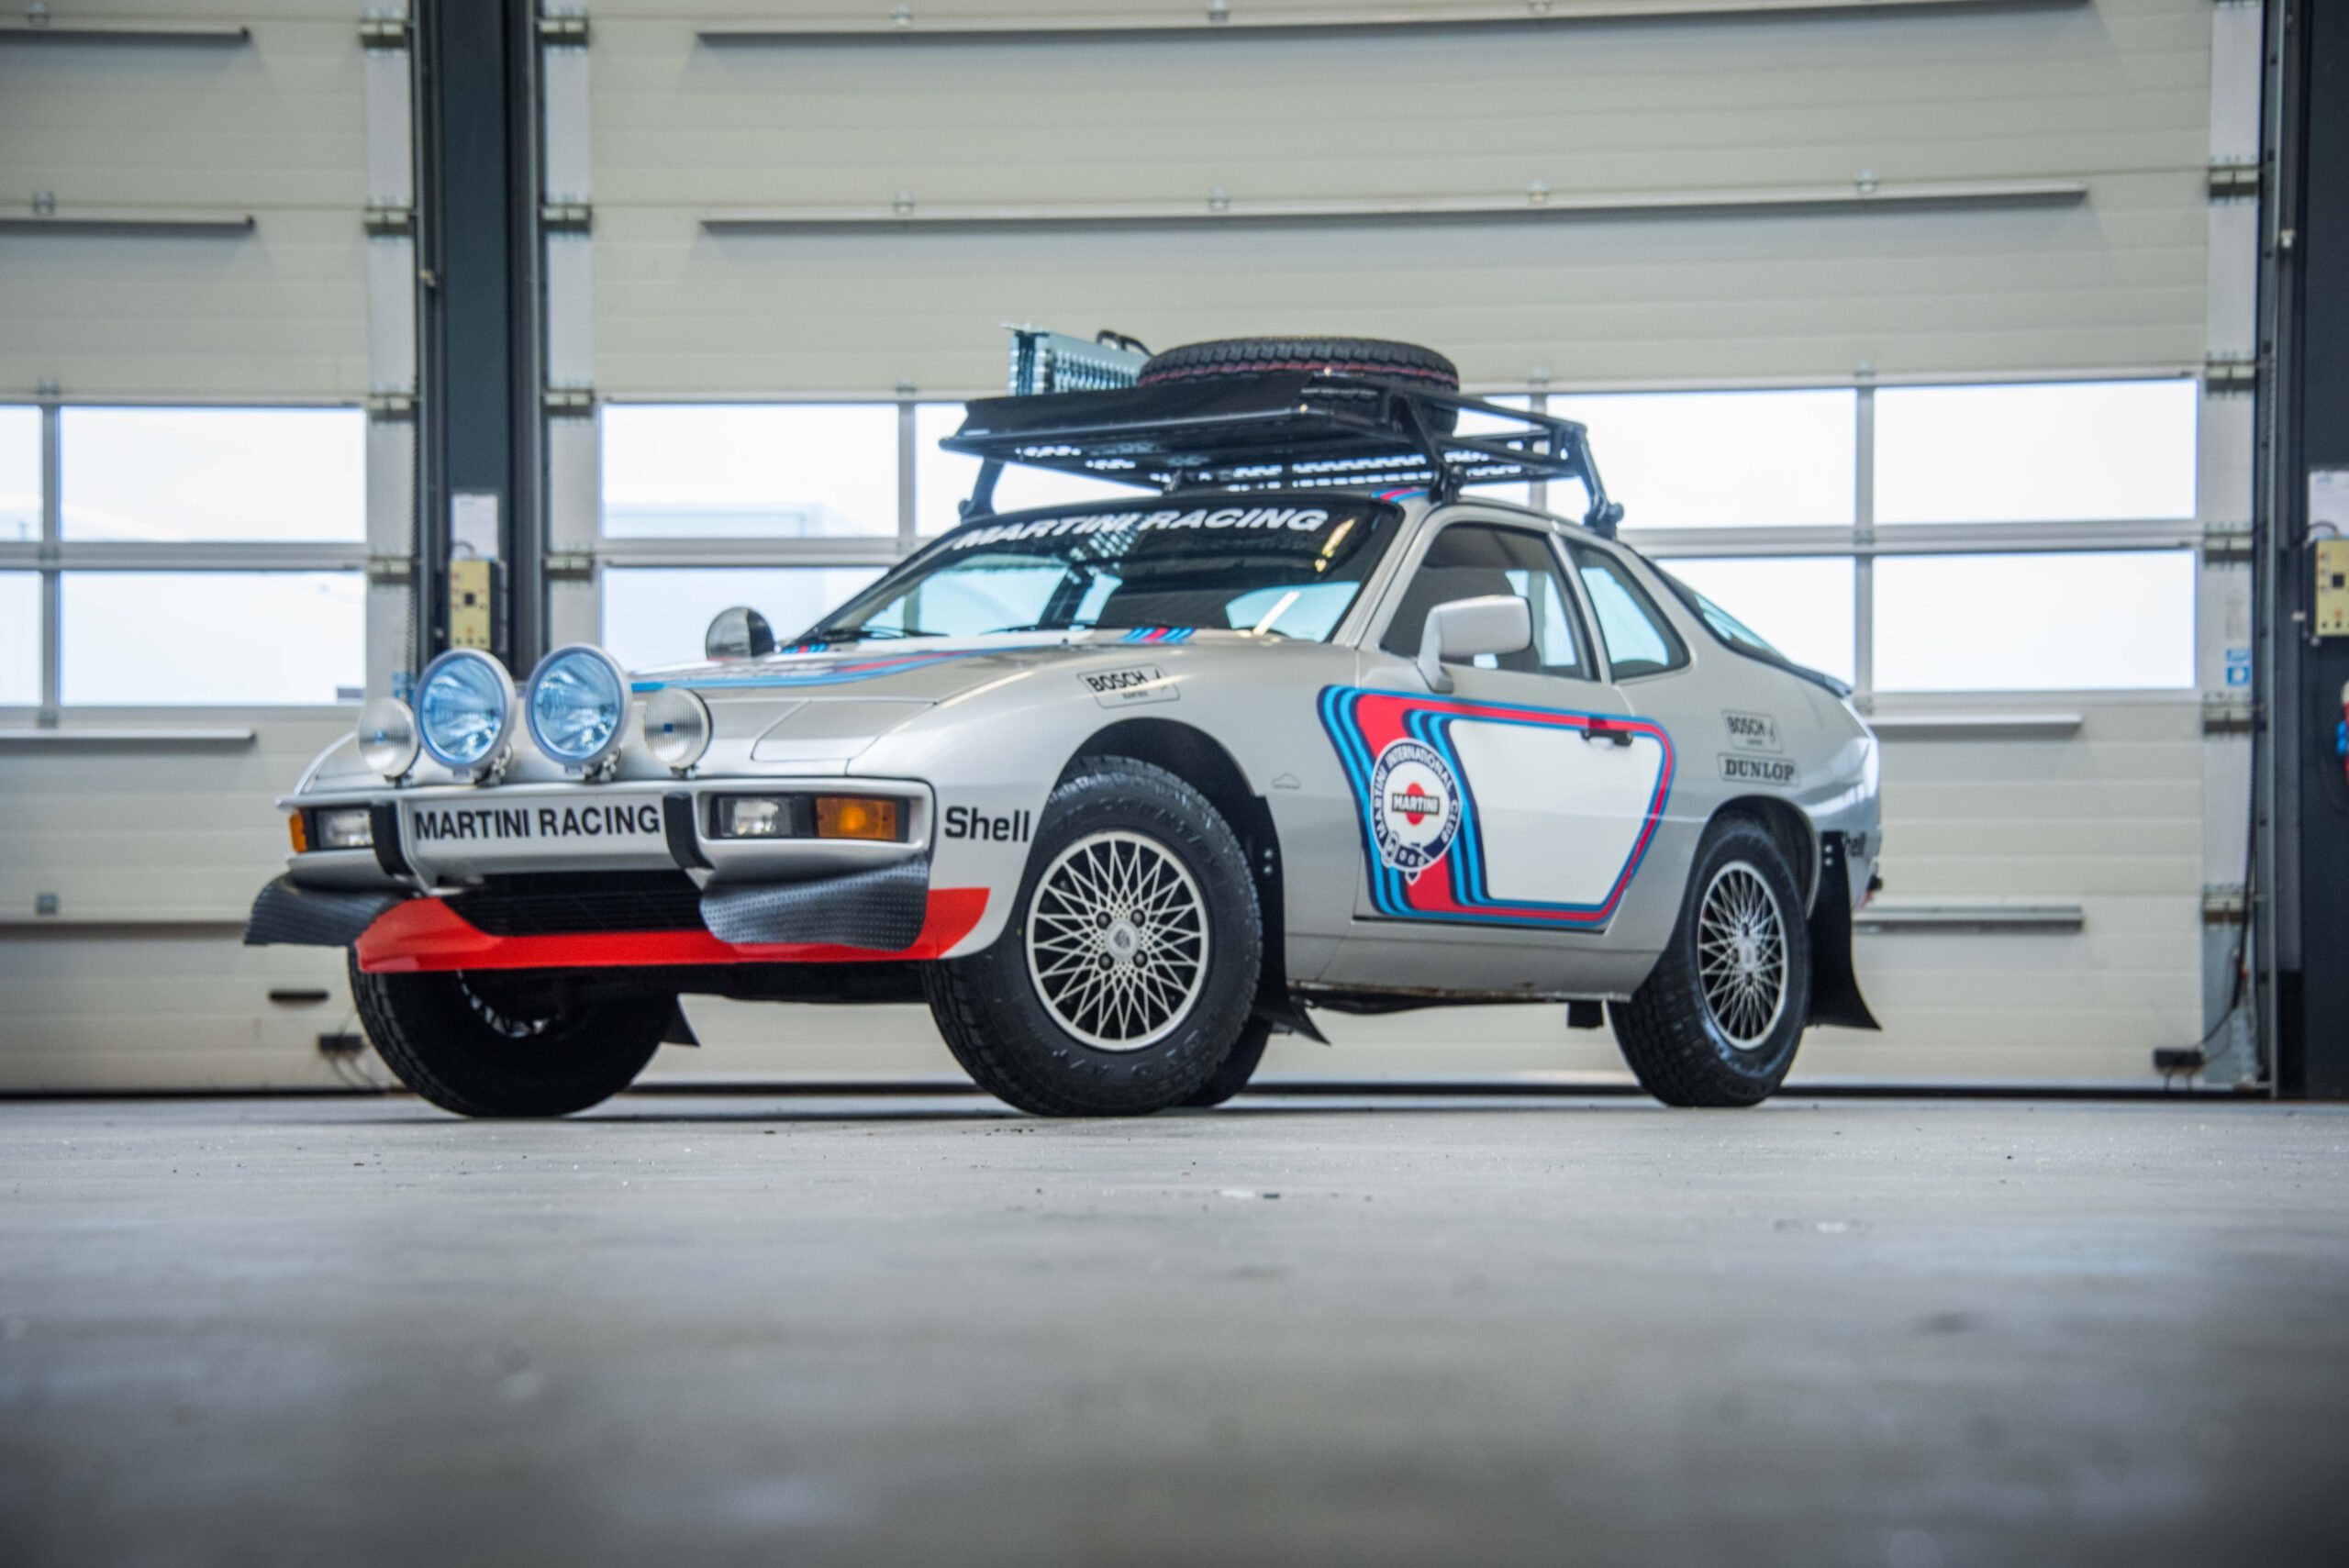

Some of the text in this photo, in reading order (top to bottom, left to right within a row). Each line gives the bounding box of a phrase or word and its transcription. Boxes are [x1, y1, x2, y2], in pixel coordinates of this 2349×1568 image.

[953, 507, 1329, 550] MARTINI RACING
[1085, 671, 1148, 693] BOSCH
[1726, 716, 1765, 736] BOSCH
[1725, 758, 1795, 782] DUNLOP
[1374, 744, 1459, 843] MARTINI INTERNATIONAL CLUB
[1393, 795, 1437, 813] MARTINI
[414, 805, 661, 840] MARTINI RACING
[944, 806, 1030, 842] Shell
